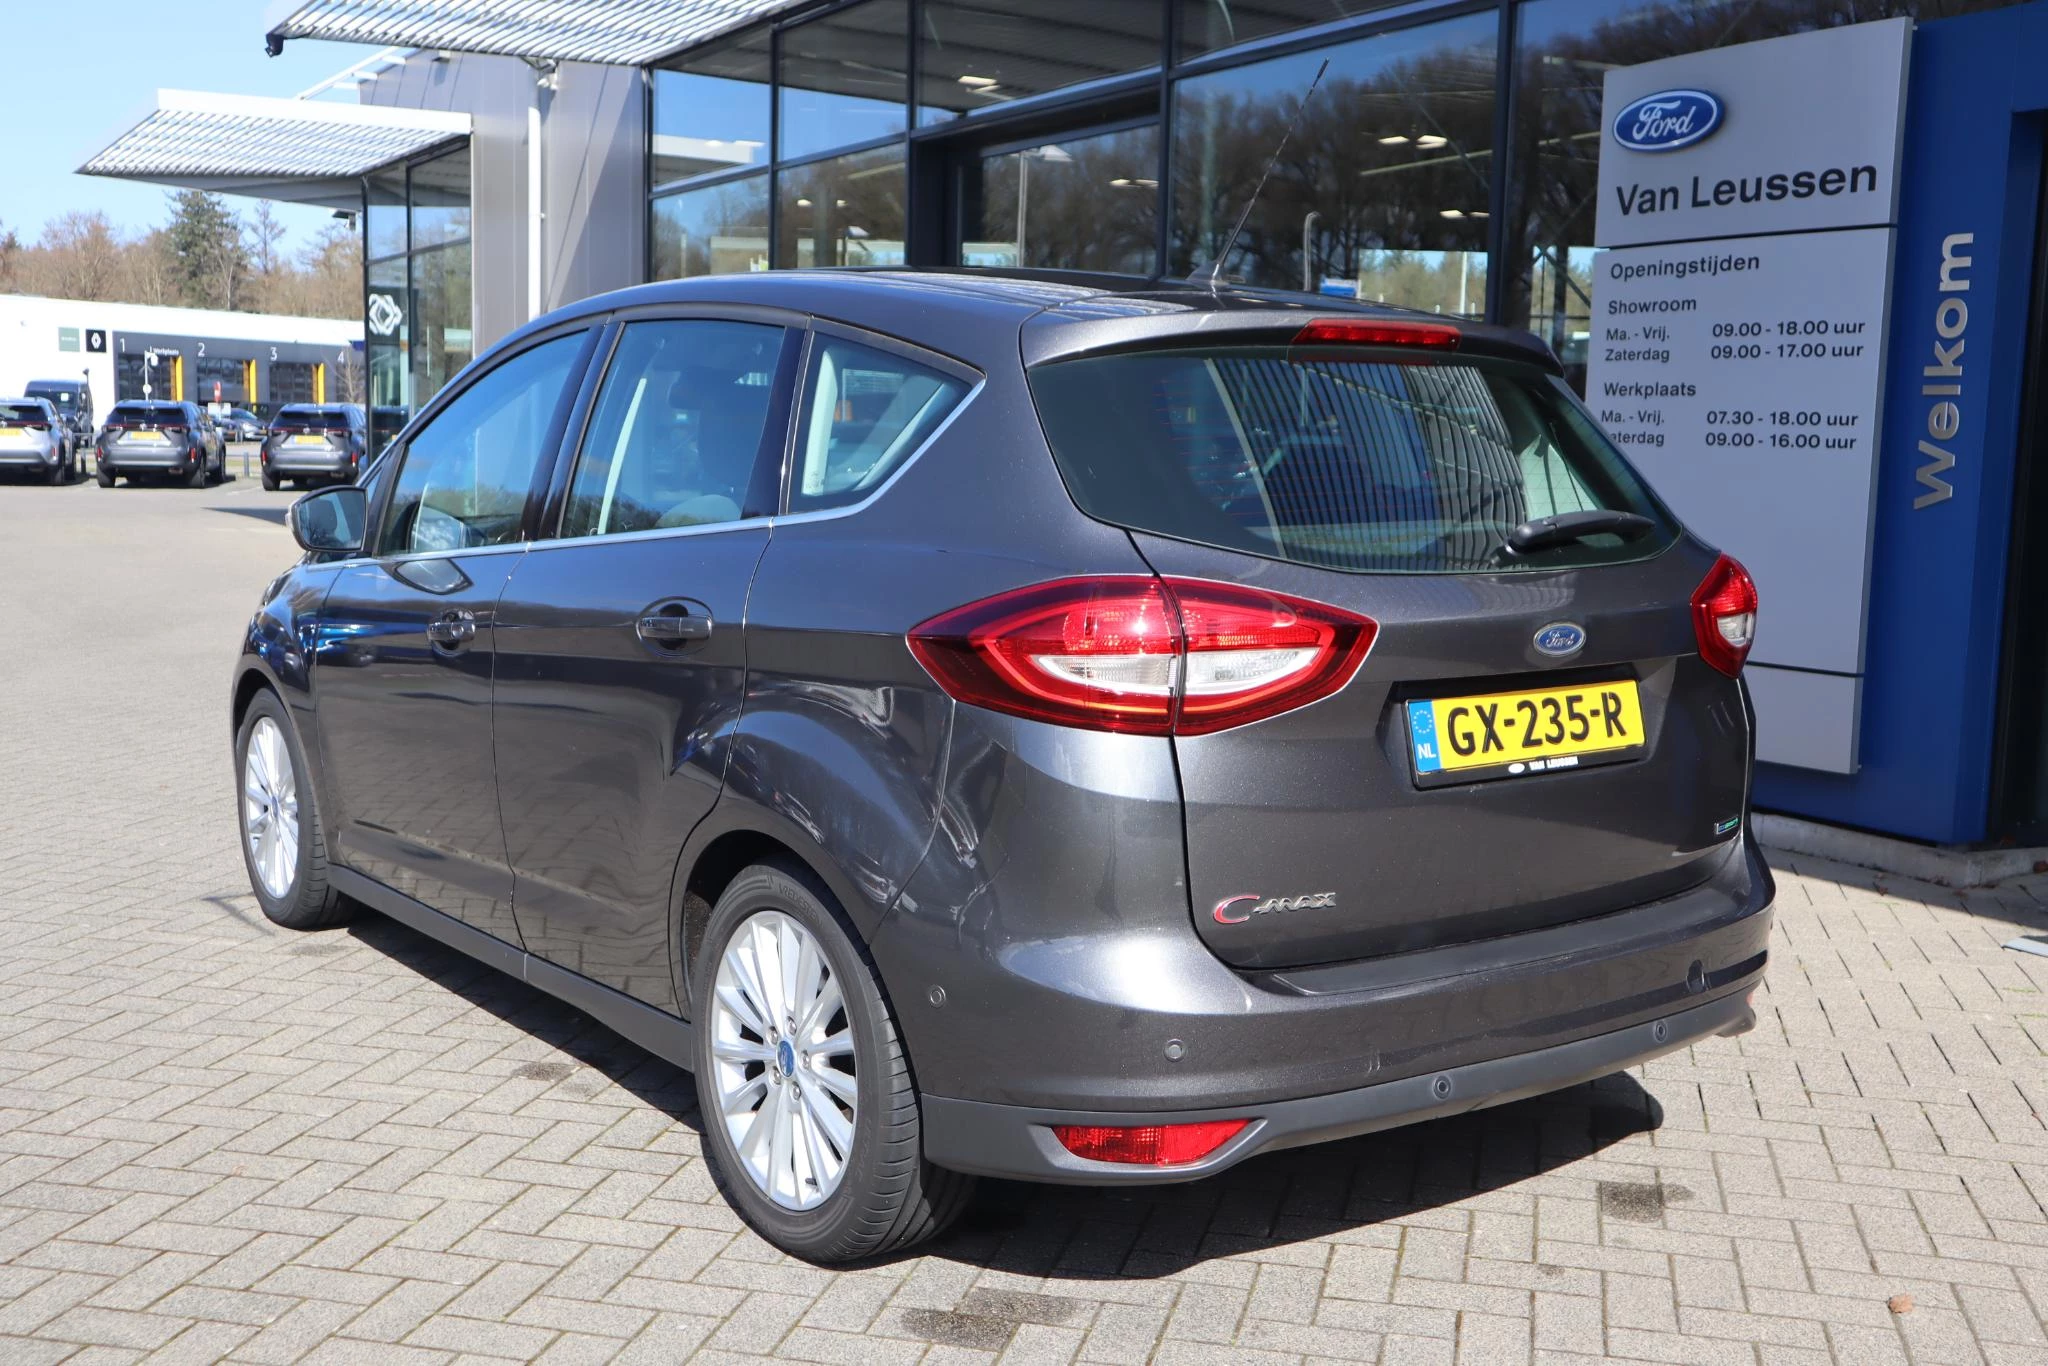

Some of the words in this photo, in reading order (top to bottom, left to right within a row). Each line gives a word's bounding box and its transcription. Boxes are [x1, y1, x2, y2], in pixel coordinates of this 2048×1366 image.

[1631, 99, 1697, 141] Ford
[1616, 183, 1680, 216] Van
[1691, 164, 1878, 208] Leussen
[1610, 254, 1761, 282] Openingstijden
[1607, 297, 1697, 316] Showroom
[1605, 327, 1631, 342] Ma.
[1641, 325, 1670, 343] Vrij.
[1711, 322, 1762, 338] 09.00
[1776, 319, 1830, 336] 18.00
[1833, 321, 1866, 335] uur
[119, 338, 126, 353] 1
[197, 342, 206, 357] 2
[270, 347, 278, 361] 3
[1604, 347, 1671, 364] Zaterdag
[1710, 344, 1761, 360] 09.00
[1776, 342, 1828, 358] 17.00
[1831, 345, 1864, 358] uur
[337, 351, 345, 363] 4
[1913, 232, 1974, 510] Welkom
[1603, 381, 1697, 400] Werkplaats
[1601, 410, 1626, 423] Ma.
[1637, 410, 1665, 426] Vrij.
[1706, 410, 1755, 426] 07.30
[1769, 411, 1822, 427] 18.00
[1826, 414, 1859, 427] uur
[1608, 431, 1665, 447] aterdag
[1705, 432, 1755, 448] 09.00
[1769, 433, 1822, 449] 16.00
[1825, 437, 1858, 450] uur
[1447, 691, 1627, 757] GX-235-R
[1416, 742, 1437, 760] NL
